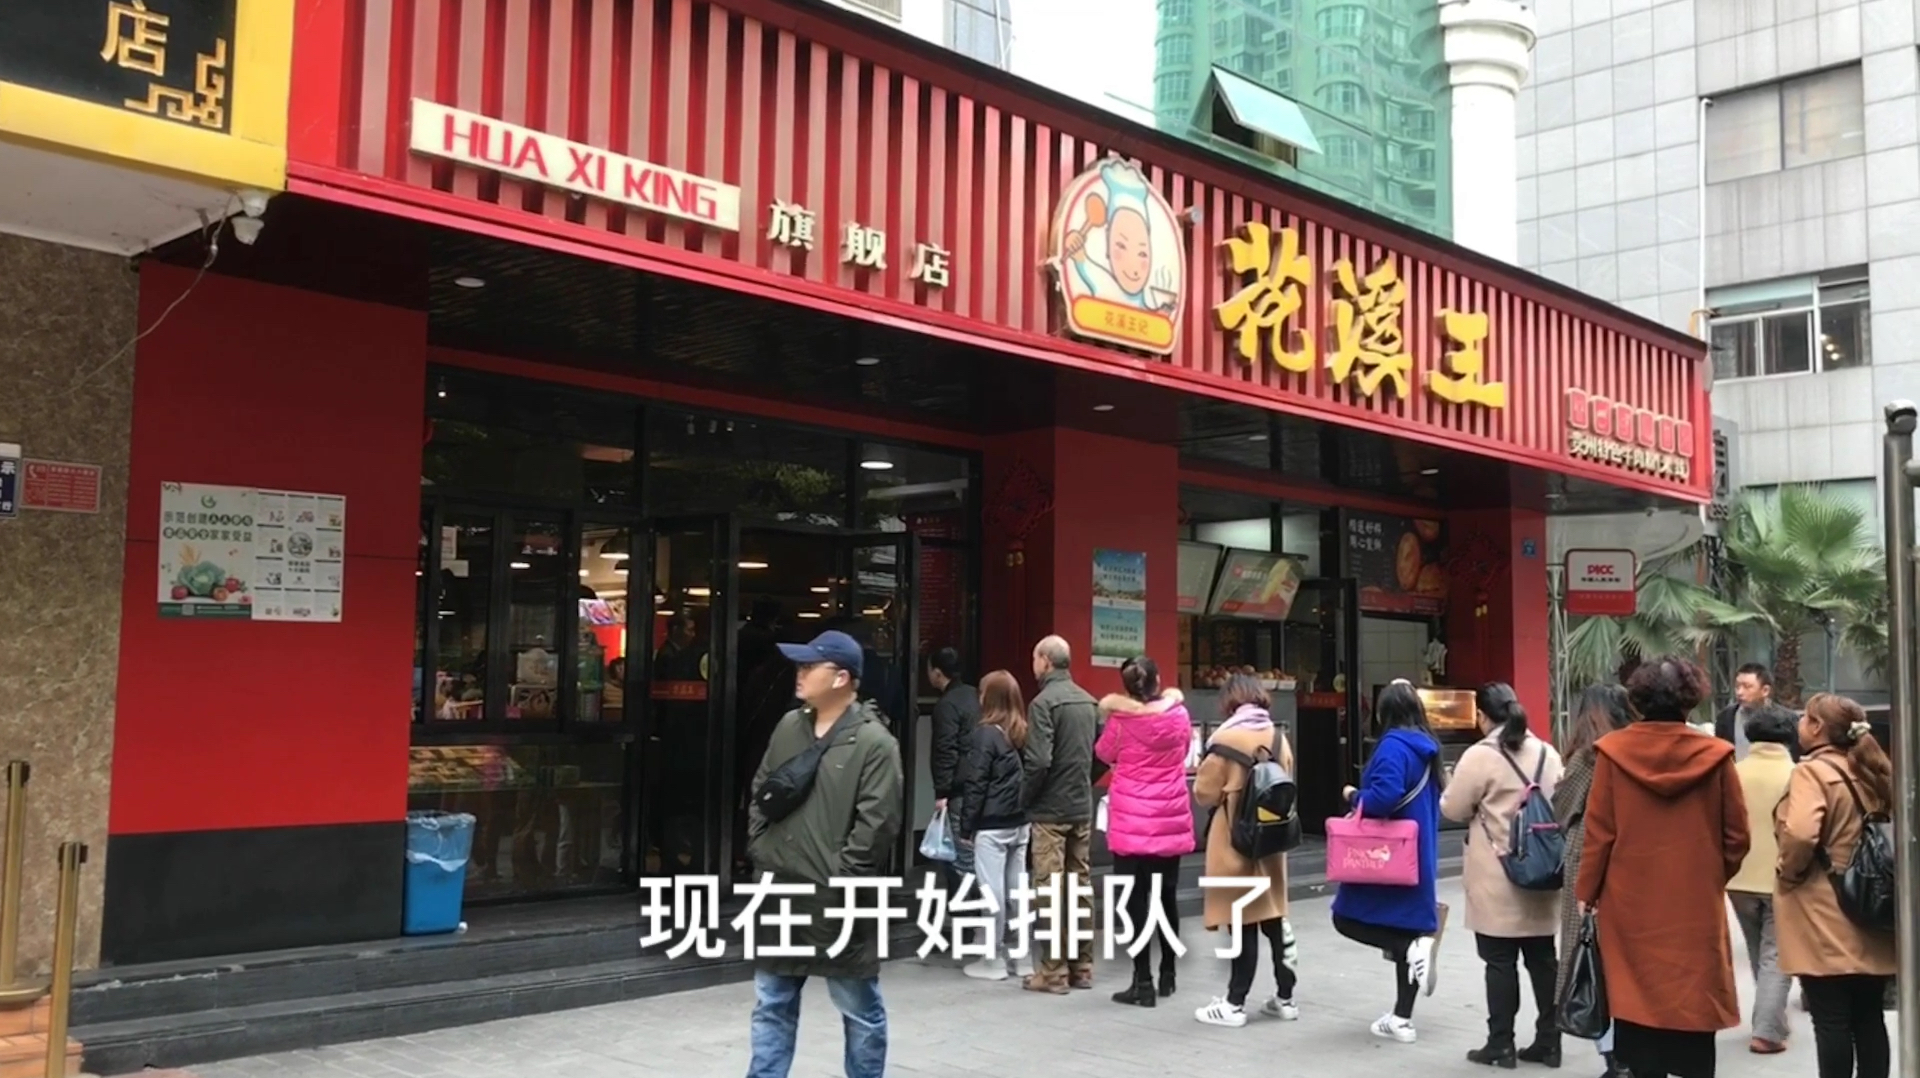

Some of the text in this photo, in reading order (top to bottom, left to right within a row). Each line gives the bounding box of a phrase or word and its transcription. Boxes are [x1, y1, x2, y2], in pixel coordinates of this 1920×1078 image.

[100, 0, 169, 77] 店
[443, 113, 718, 222] HUA XI KING
[768, 199, 951, 289] 旗舰店
[1214, 221, 1506, 409] 花溪王
[1587, 564, 1615, 575] PICC
